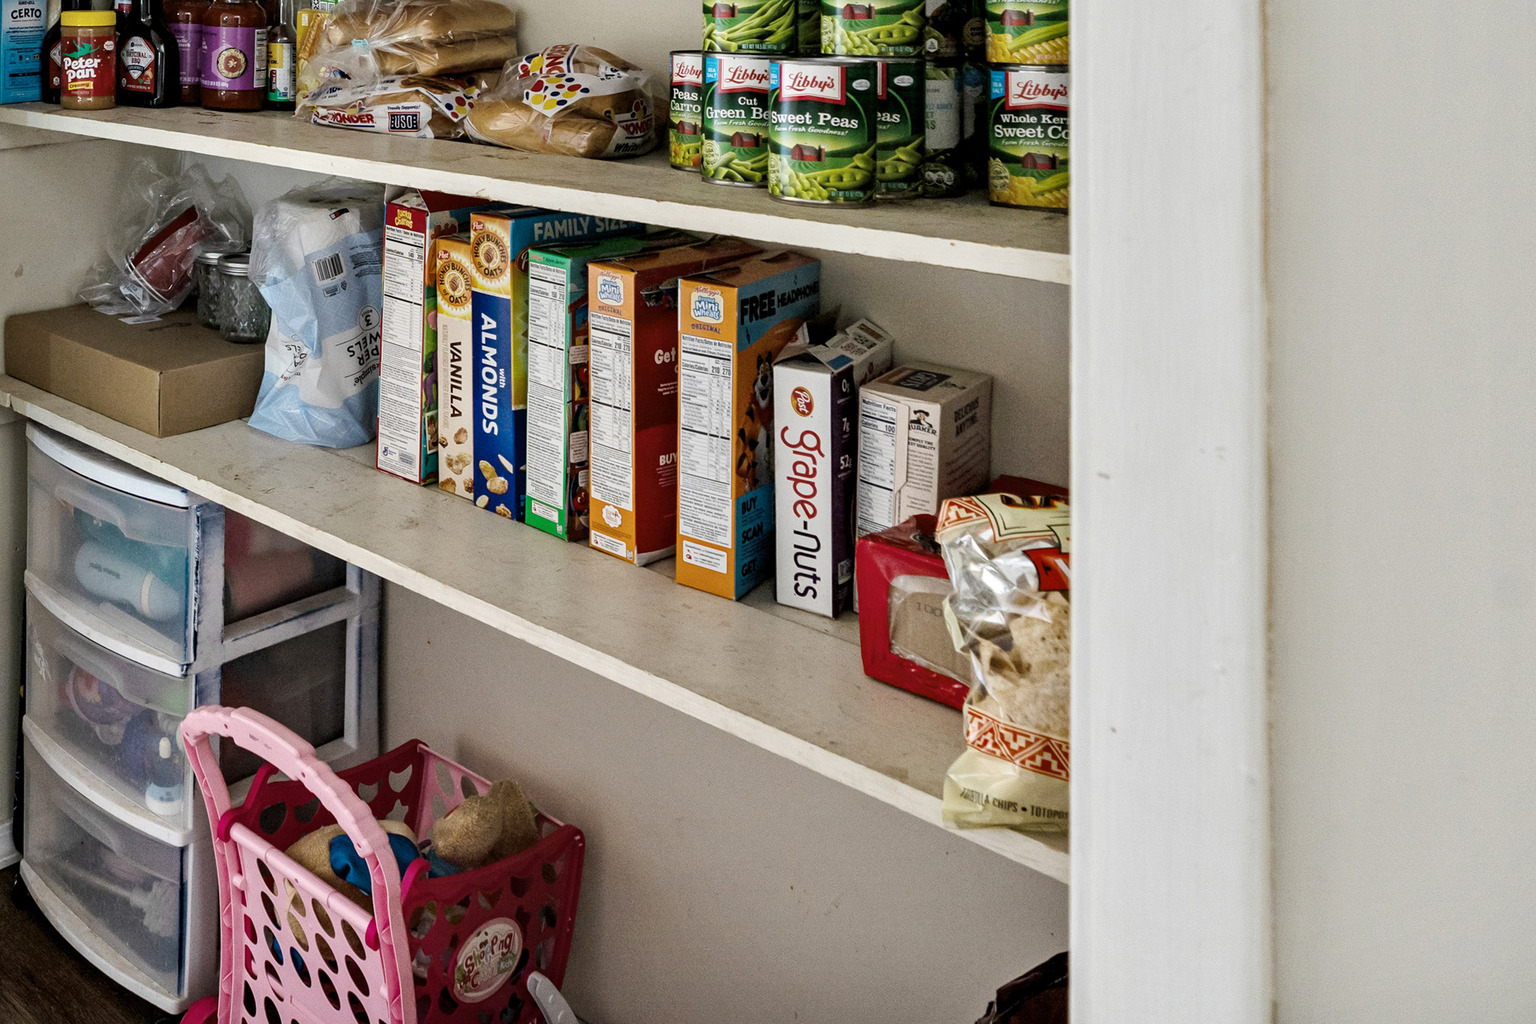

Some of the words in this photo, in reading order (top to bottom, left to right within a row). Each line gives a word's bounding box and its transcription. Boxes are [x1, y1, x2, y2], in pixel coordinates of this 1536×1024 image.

[10, 7, 42, 19] CERTO
[125, 51, 148, 60] ORIGINAL
[63, 57, 101, 72] Peter
[66, 68, 96, 82] Pan
[786, 72, 835, 92] Libby's
[673, 88, 698, 101] Peas
[1013, 80, 1068, 100] Libby's
[738, 96, 759, 106] Cut
[706, 106, 746, 120] Green
[771, 110, 812, 124] Sweet
[818, 112, 859, 128] Peas
[1000, 114, 1037, 124] Whole
[394, 116, 412, 129] USO
[728, 119, 747, 127] Fresh
[788, 125, 807, 133] Fresh
[807, 126, 848, 136] Goodness!
[994, 125, 1044, 138] Sweet
[1019, 139, 1039, 147] Fresh
[473, 222, 484, 230] Post
[534, 217, 590, 241] FAMILY
[474, 235, 485, 257] HONEY
[486, 234, 506, 263] BUNCHES
[438, 251, 449, 259] Post
[478, 261, 483, 269] of
[484, 265, 502, 276] OATS
[440, 264, 450, 285] HONEY
[451, 263, 470, 291] BUNCHES
[600, 270, 622, 280] Kellogg's
[600, 284, 619, 294] Mini
[694, 286, 722, 296] Kellogg's
[449, 294, 467, 304] OATS
[599, 292, 621, 303] Wheats
[598, 306, 622, 315] ORIGINAL
[696, 301, 719, 312] Mini
[740, 290, 776, 325] FREE
[694, 309, 720, 320] Wheats
[364, 316, 372, 327] 3
[691, 323, 720, 334] ORIGINAL
[654, 348, 676, 365] Get
[354, 364, 377, 385] simple
[481, 313, 498, 436] ALMONDS
[711, 365, 720, 374] 210
[722, 368, 731, 376] 270
[450, 342, 462, 417] VANILLA
[795, 388, 810, 417] Post
[863, 399, 882, 408] Nutrition
[883, 405, 896, 413] Facts
[955, 397, 979, 422] DELICIOUS
[862, 420, 879, 429] Calories
[885, 425, 895, 434] 100
[659, 454, 677, 466] BUY
[742, 496, 757, 515] BUY
[780, 424, 825, 600] grape-nuts
[742, 521, 763, 544] SCAN
[742, 558, 756, 577] GET
[992, 798, 1019, 812] CHIPS
